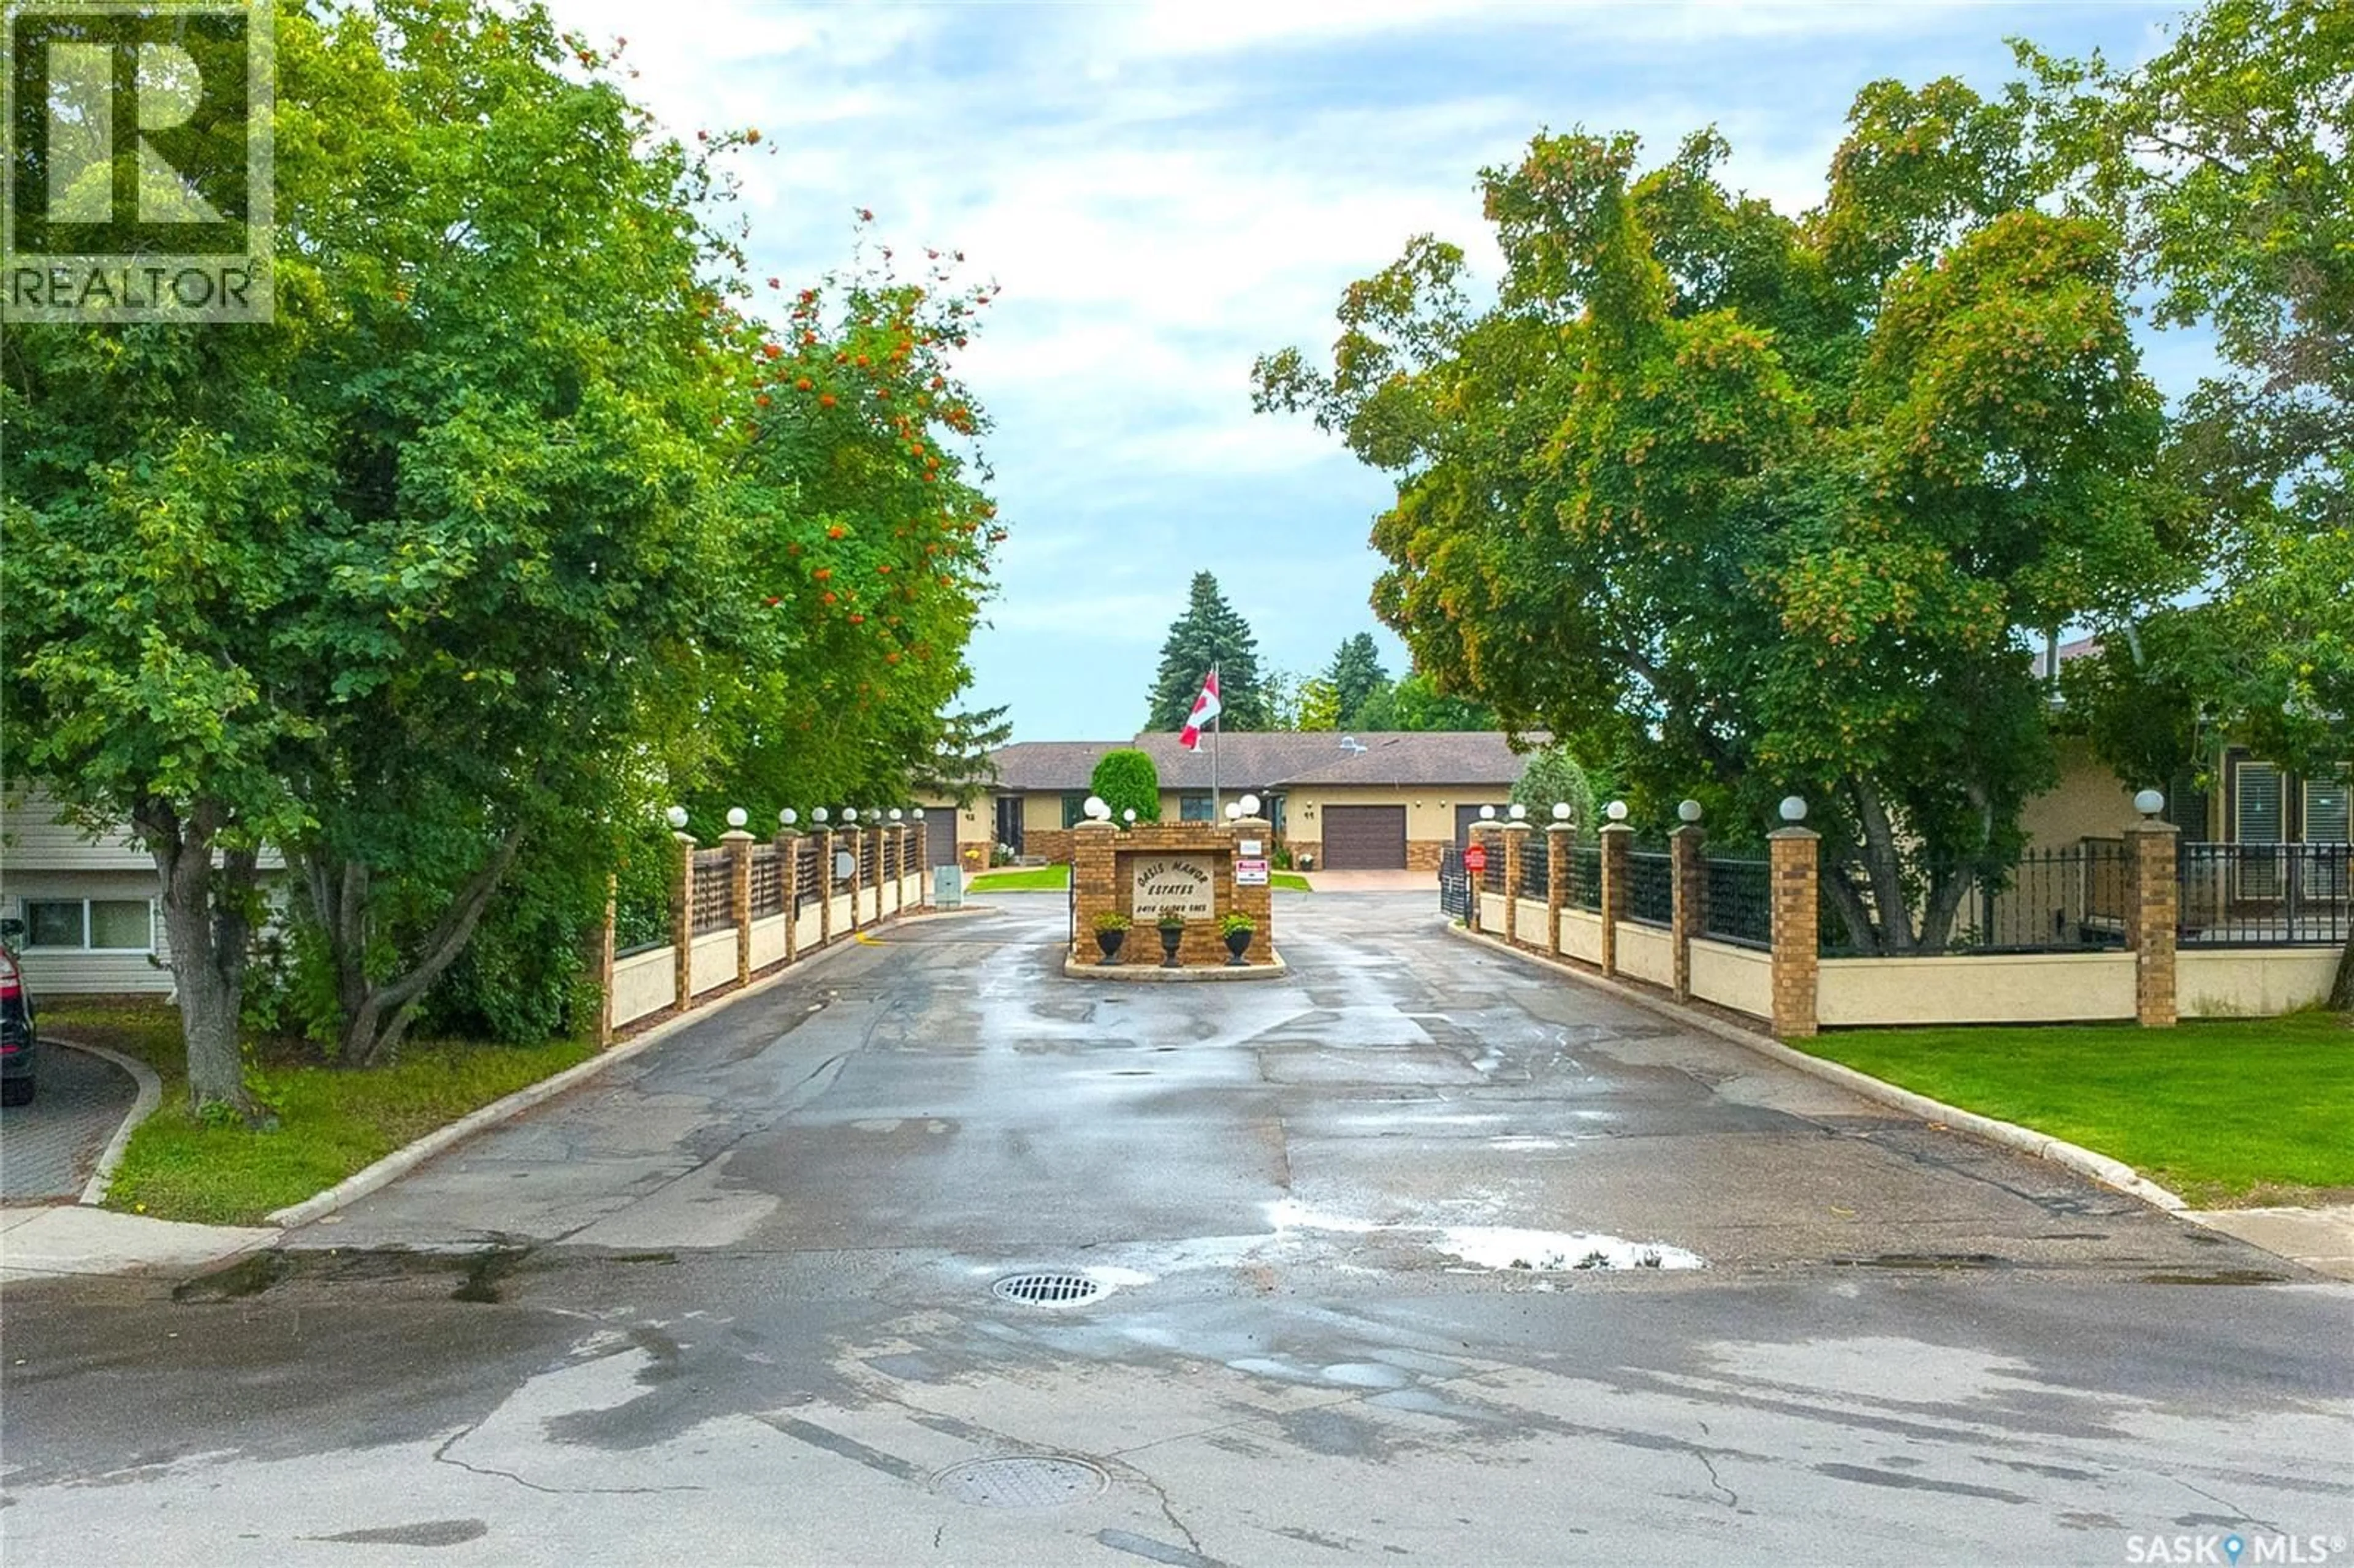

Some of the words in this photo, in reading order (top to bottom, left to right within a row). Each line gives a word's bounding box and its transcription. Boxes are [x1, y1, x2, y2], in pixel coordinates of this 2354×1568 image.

[1137, 862, 1164, 888] OASIS
[1172, 860, 1208, 883] MANOR
[1148, 885, 1194, 895] ESTATES
